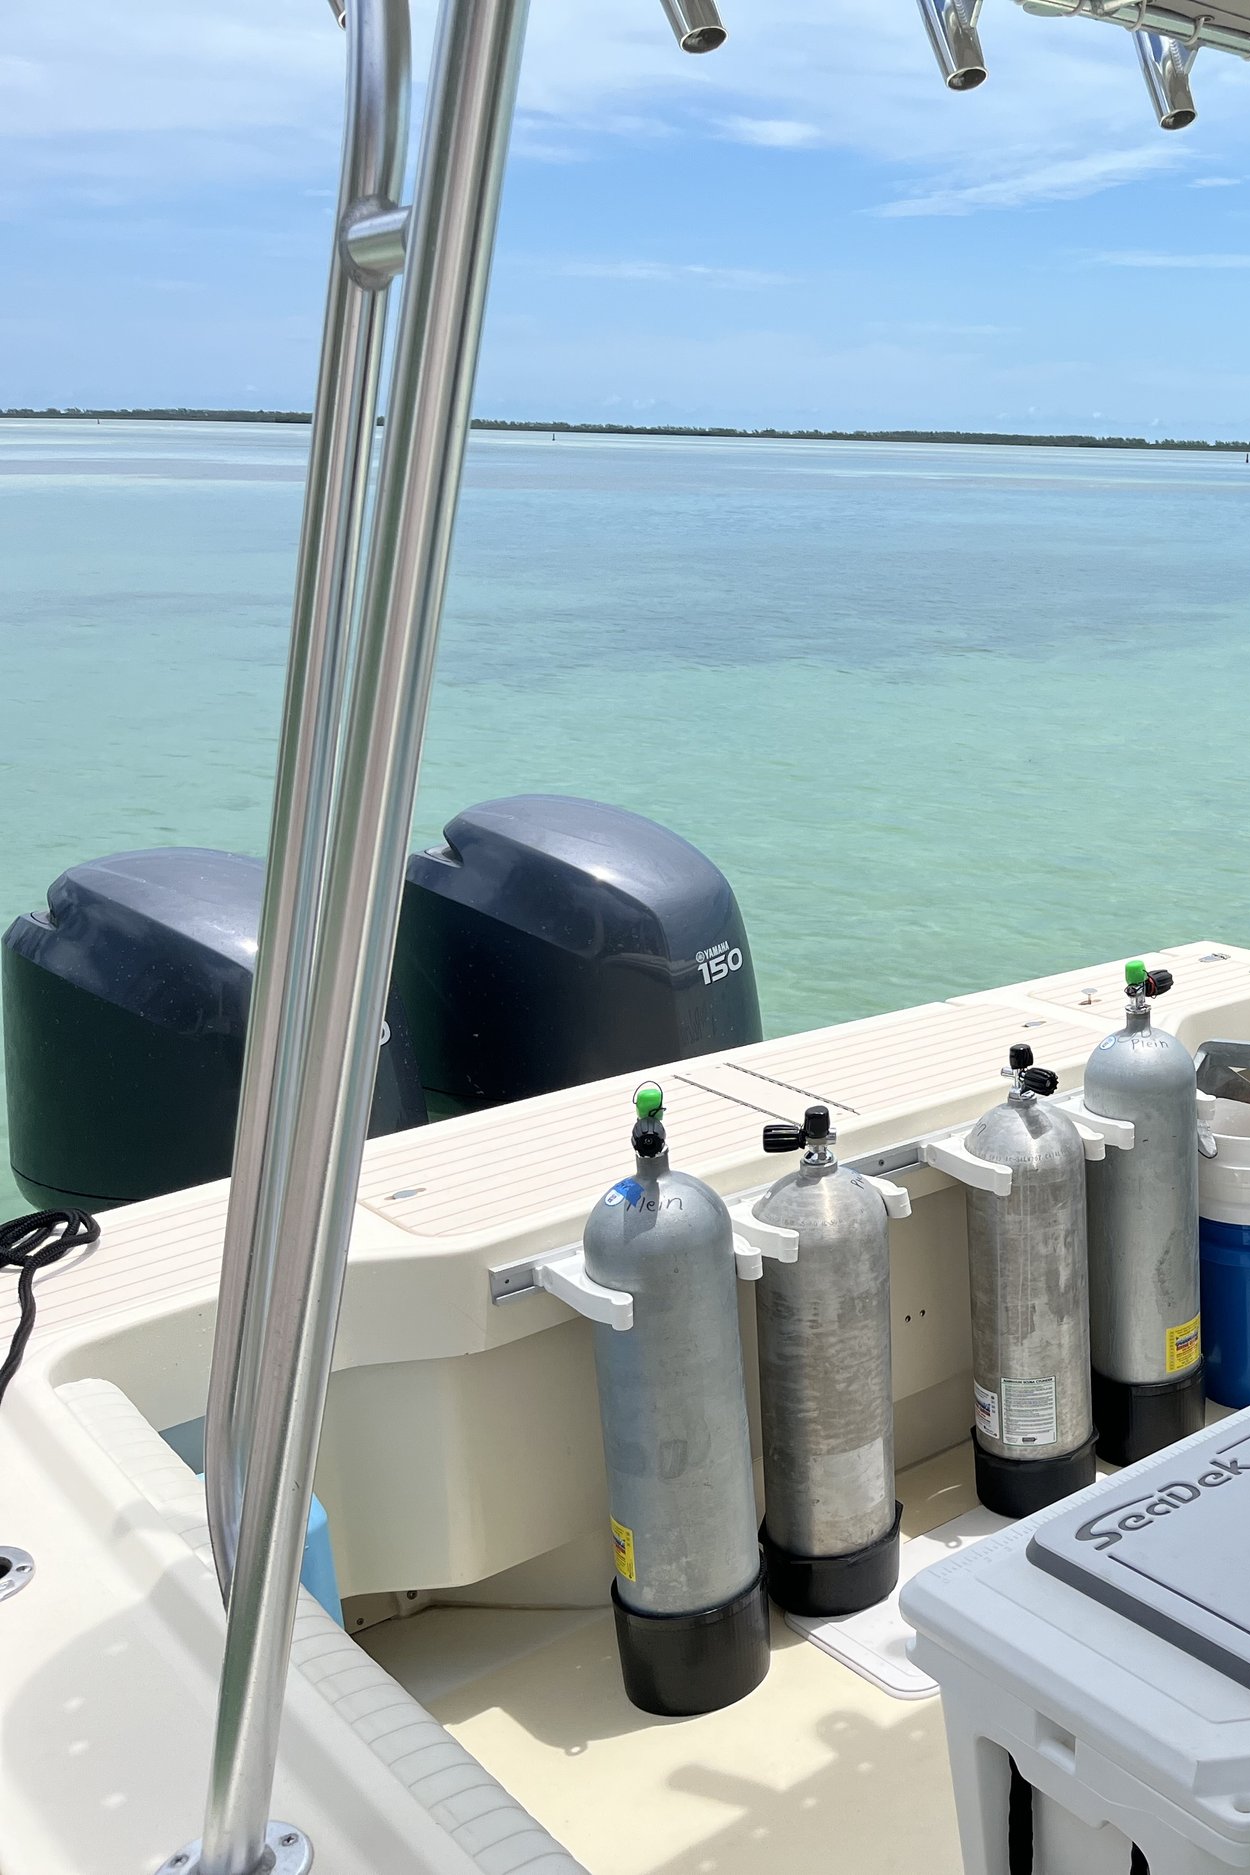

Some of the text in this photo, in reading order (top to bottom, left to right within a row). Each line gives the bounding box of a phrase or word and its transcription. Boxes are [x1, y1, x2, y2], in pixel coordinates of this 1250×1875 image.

[703, 940, 730, 960] YAMAHA
[697, 947, 743, 985] 150
[1131, 1038, 1169, 1050] Plein
